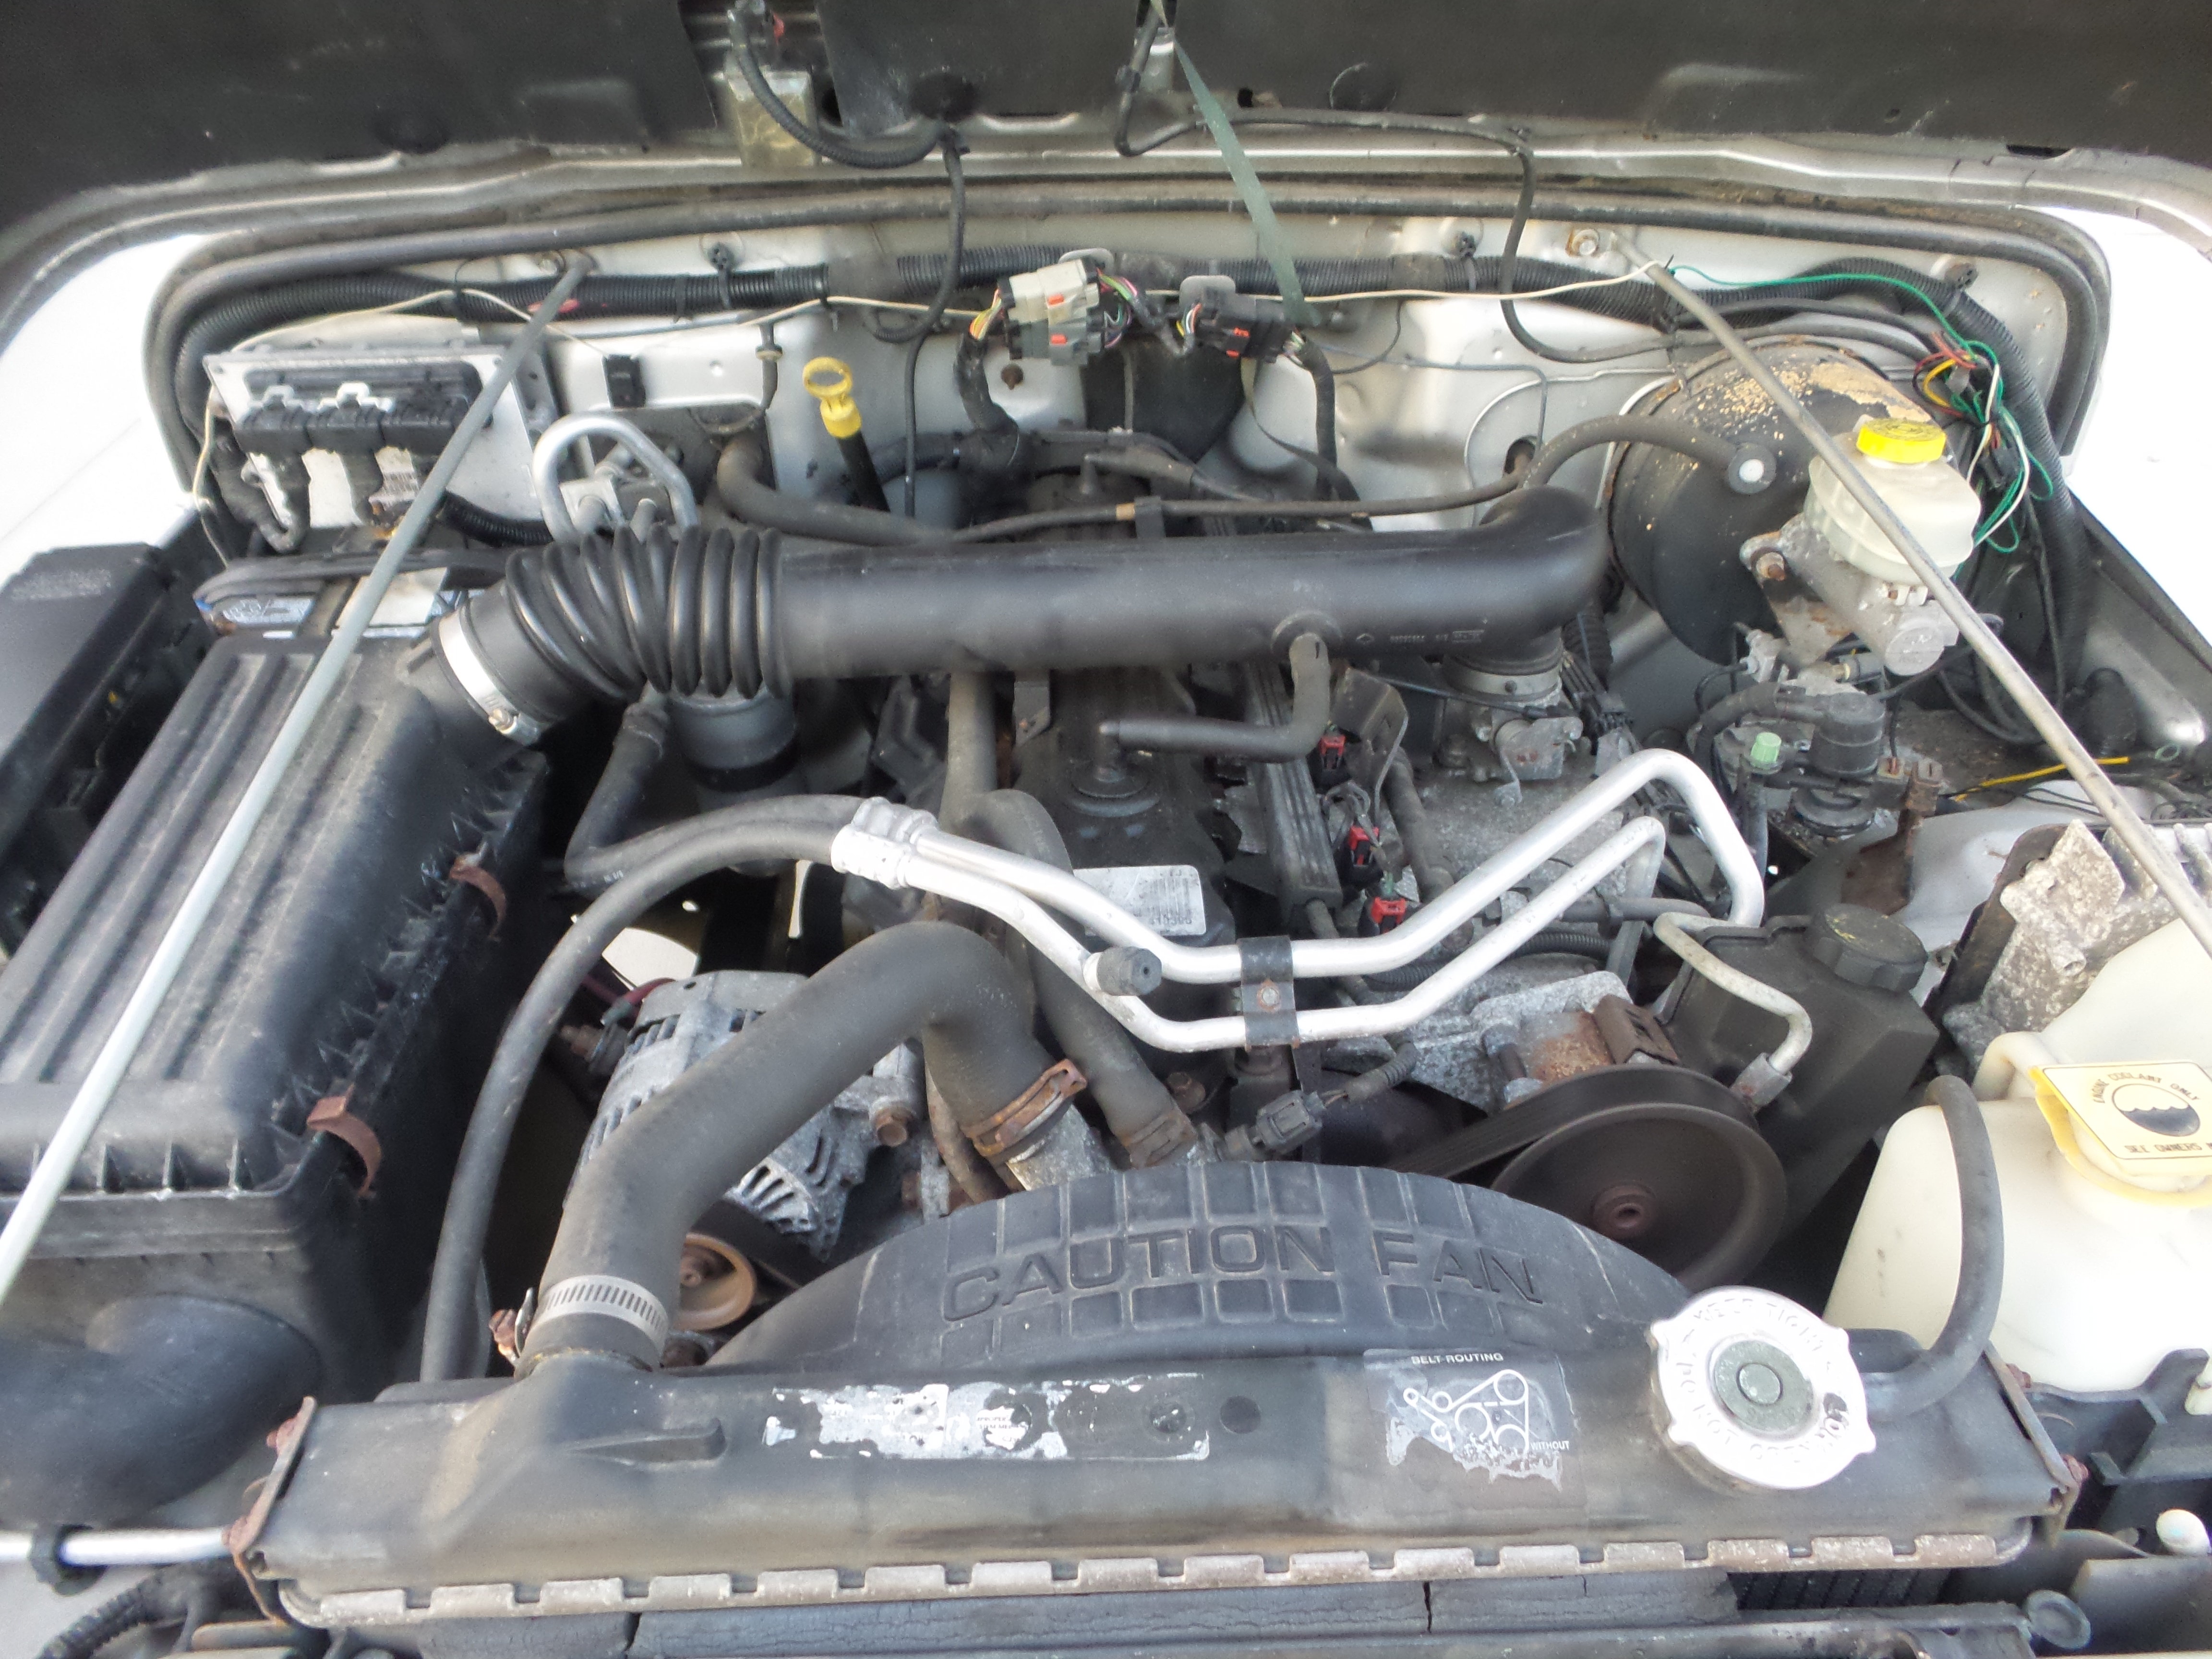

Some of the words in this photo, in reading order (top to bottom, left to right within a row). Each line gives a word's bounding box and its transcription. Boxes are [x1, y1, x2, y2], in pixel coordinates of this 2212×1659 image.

[942, 1225, 1336, 1322] CAUTION
[1371, 1227, 1544, 1305] FAN
[1410, 1355, 1442, 1365] BELT
[1446, 1352, 1504, 1364] ROUTING
[1530, 1440, 1570, 1450] WITHOUT
